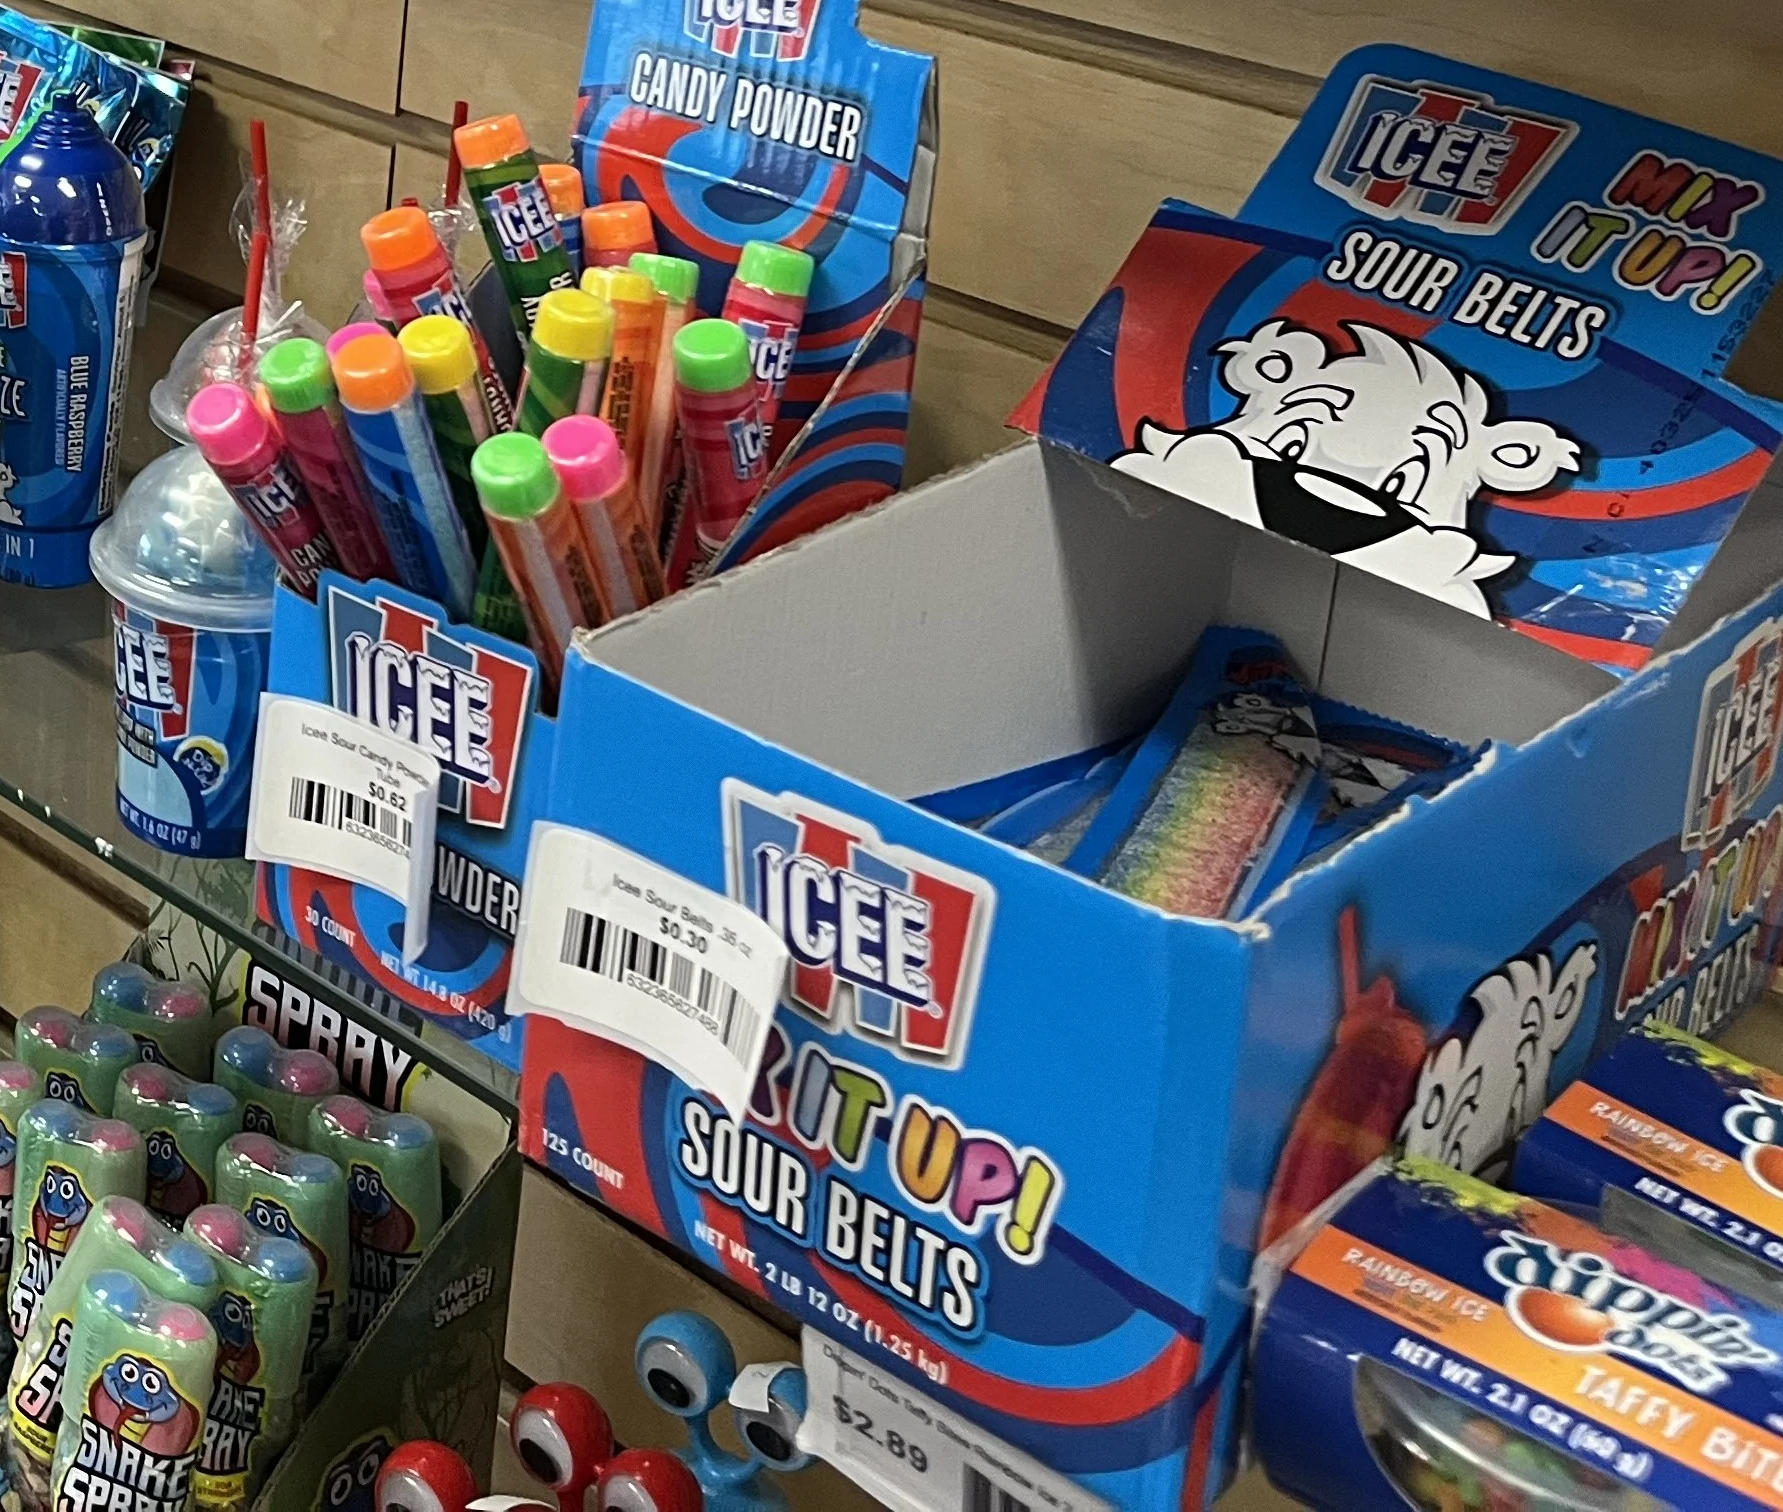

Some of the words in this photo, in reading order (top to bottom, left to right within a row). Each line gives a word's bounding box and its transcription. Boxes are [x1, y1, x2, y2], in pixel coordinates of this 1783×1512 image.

[630, 52, 728, 124] CANDY
[729, 76, 864, 163] POWDER
[1343, 110, 1519, 201] ICEE
[491, 190, 556, 251] ICEE
[1610, 152, 1761, 239] MIX
[1325, 229, 1462, 314] SOUR
[1452, 270, 1608, 362] BELTS
[1535, 204, 1630, 270] IT
[1618, 228, 1759, 311] UP!
[70, 354, 90, 390] BLUE
[66, 391, 89, 474] RASPBERRY
[301, 722, 329, 742] Icee
[330, 731, 357, 752] Sour
[358, 743, 394, 771] Candy
[344, 630, 494, 790] ICEE
[368, 781, 408, 813] $0.62
[375, 766, 401, 789] Tube
[156, 824, 170, 841] OZ
[171, 826, 189, 846] (47
[305, 905, 321, 926] 30
[320, 915, 357, 949] COUNT
[612, 872, 642, 899] Icee
[644, 888, 678, 915] Sour
[680, 904, 715, 934] Belts
[658, 915, 709, 955] $0.30
[754, 843, 932, 1009] ICEE
[449, 989, 467, 1014] OZ
[466, 997, 496, 1031] (420
[541, 1126, 570, 1158] 125
[572, 1147, 626, 1191] COUNT
[791, 1048, 887, 1168] IT
[897, 1102, 1058, 1258] UP!
[1589, 1099, 1692, 1154] RAINBOW
[1693, 1142, 1731, 1174] ICE
[679, 1098, 809, 1236] SOUR
[826, 1174, 982, 1332] BELTS
[1633, 1175, 1678, 1208] NET
[432, 1287, 494, 1332] SWEET!
[693, 1219, 727, 1252] NET
[763, 1259, 780, 1283] 2
[780, 1268, 804, 1298] LB
[807, 1282, 830, 1312] 12
[831, 1298, 862, 1332] OZ
[863, 1319, 913, 1358] (1.25
[917, 1347, 950, 1386] kg)
[1340, 1244, 1450, 1303] RAINBOW
[1451, 1291, 1490, 1324] ICE
[831, 1394, 929, 1475] $2.89
[1392, 1336, 1437, 1371] NET
[1438, 1361, 1483, 1393] WT.
[1484, 1380, 1528, 1415] 2.1
[1530, 1402, 1571, 1435] OZ
[1570, 1422, 1618, 1463] (60
[1617, 1445, 1652, 1482] g)
[1572, 1364, 1701, 1442] TAFFY
[77, 1412, 198, 1501] SNAKE
